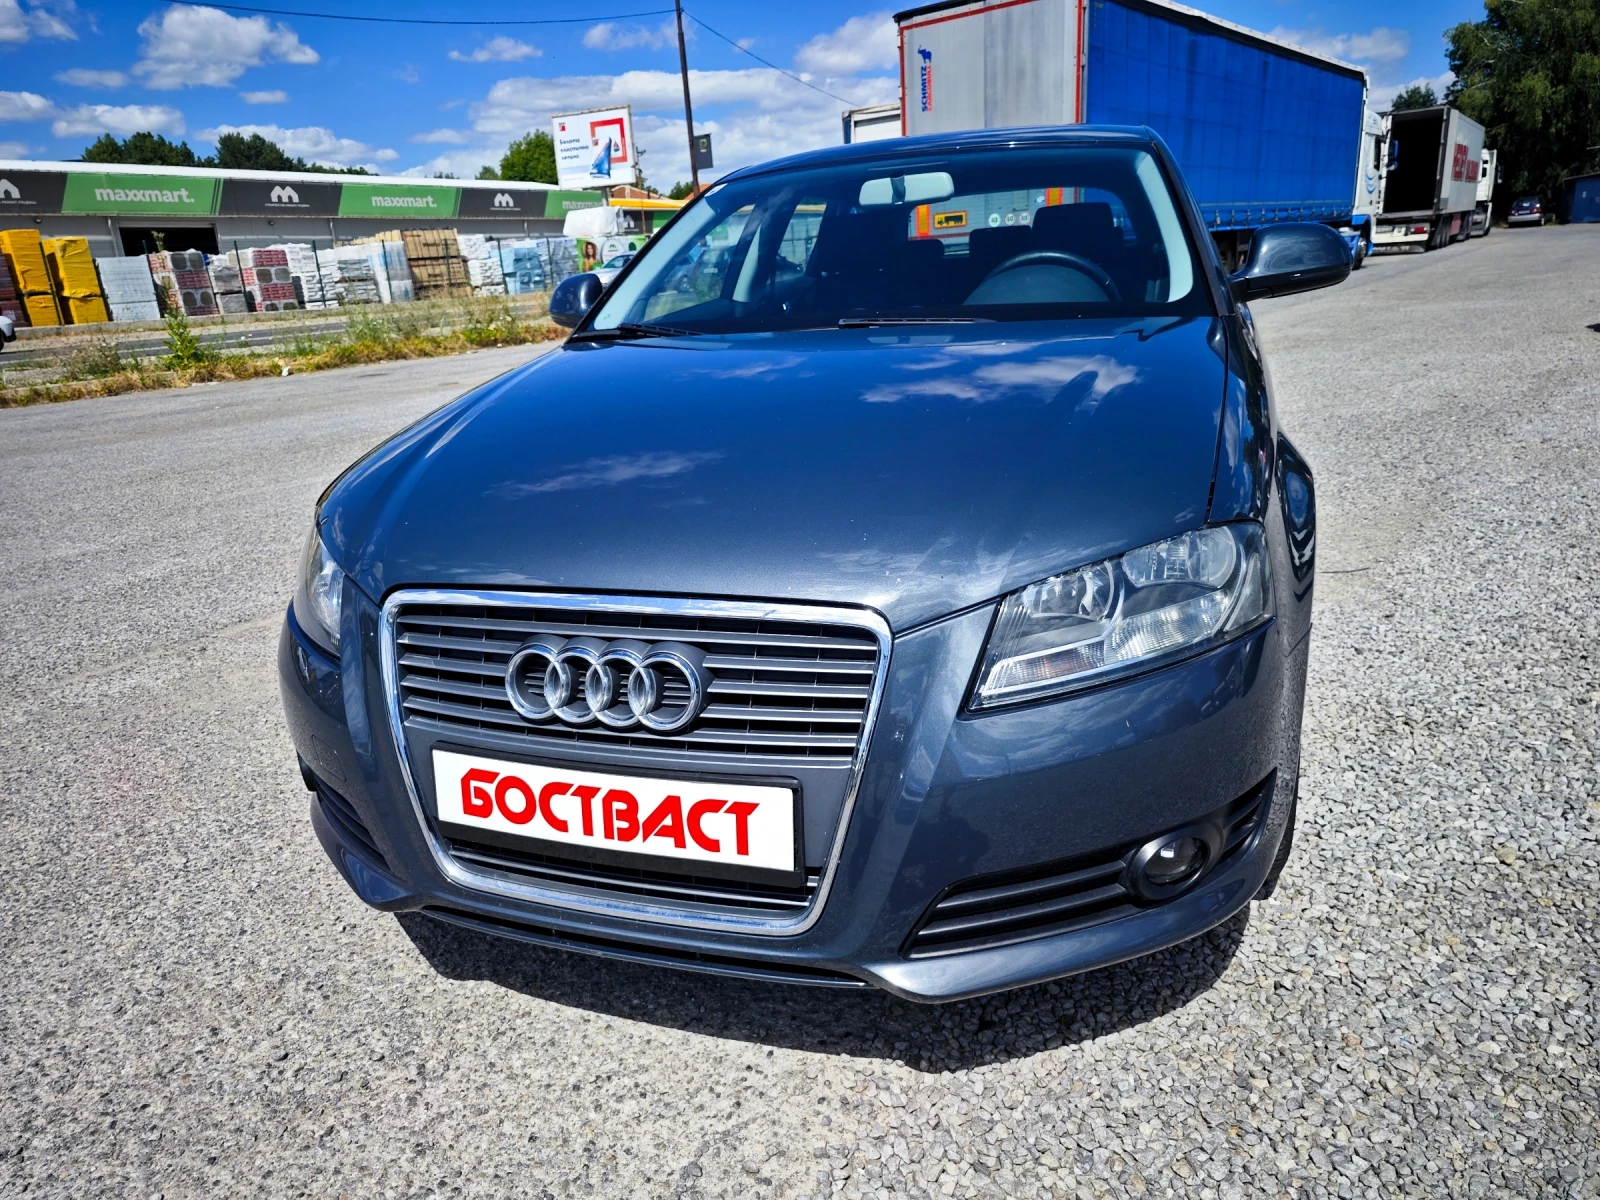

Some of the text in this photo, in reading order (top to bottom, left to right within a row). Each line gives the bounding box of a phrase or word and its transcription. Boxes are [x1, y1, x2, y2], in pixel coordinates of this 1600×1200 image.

[94, 187, 195, 203] maxxmart.
[371, 195, 437, 208] maxxmart.
[461, 768, 760, 856] БОСТВАСТ
